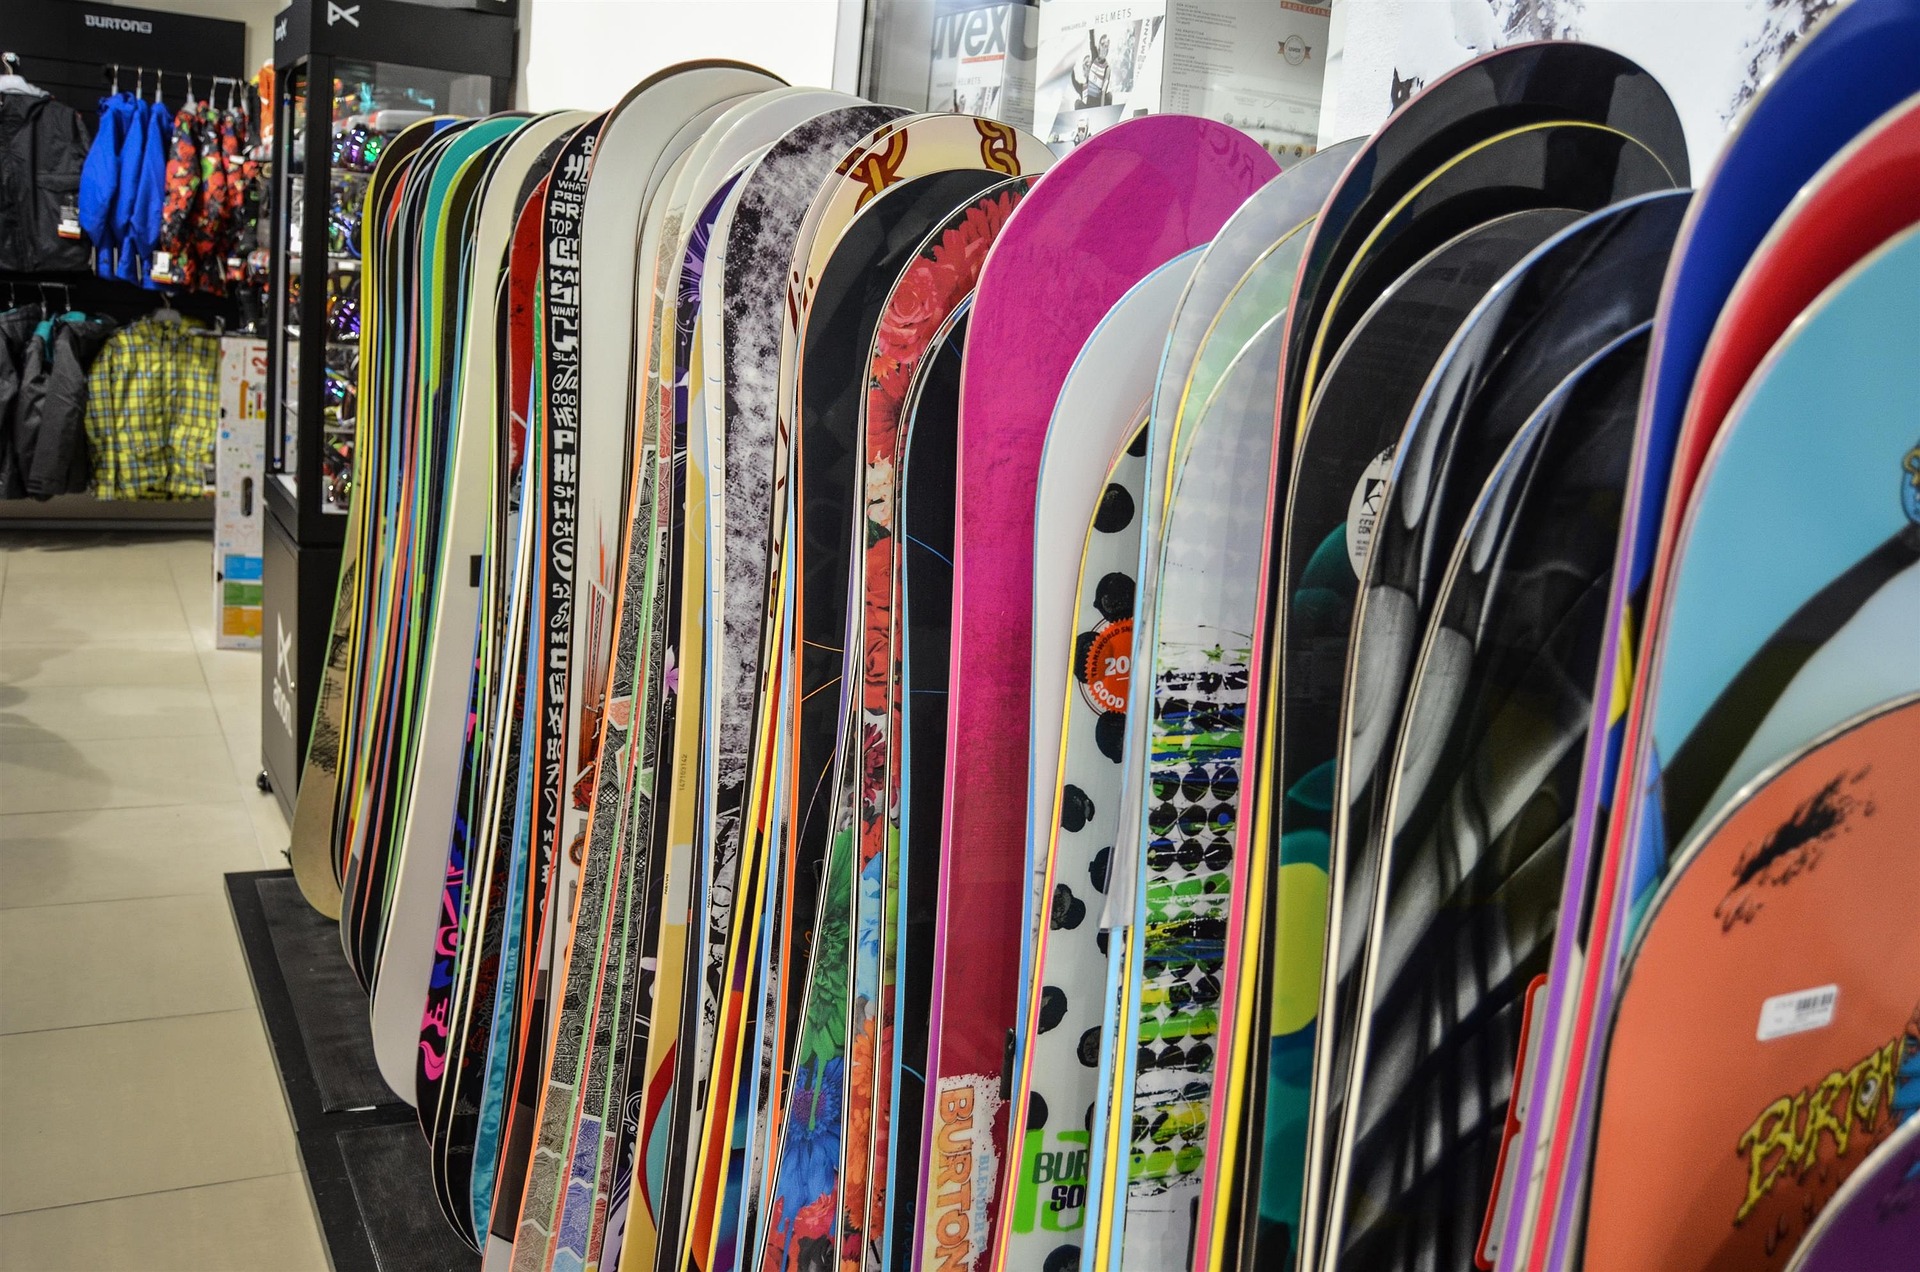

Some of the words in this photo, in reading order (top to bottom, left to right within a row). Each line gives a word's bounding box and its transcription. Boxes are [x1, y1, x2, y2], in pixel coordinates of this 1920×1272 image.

[85, 14, 141, 33] BURTON
[1094, 8, 1132, 24] HELMETS
[1091, 628, 1121, 677] TRANSWORLD
[1093, 680, 1124, 709] GOOD
[935, 1087, 975, 1272] BURTON
[973, 1154, 990, 1234] BLENDER
